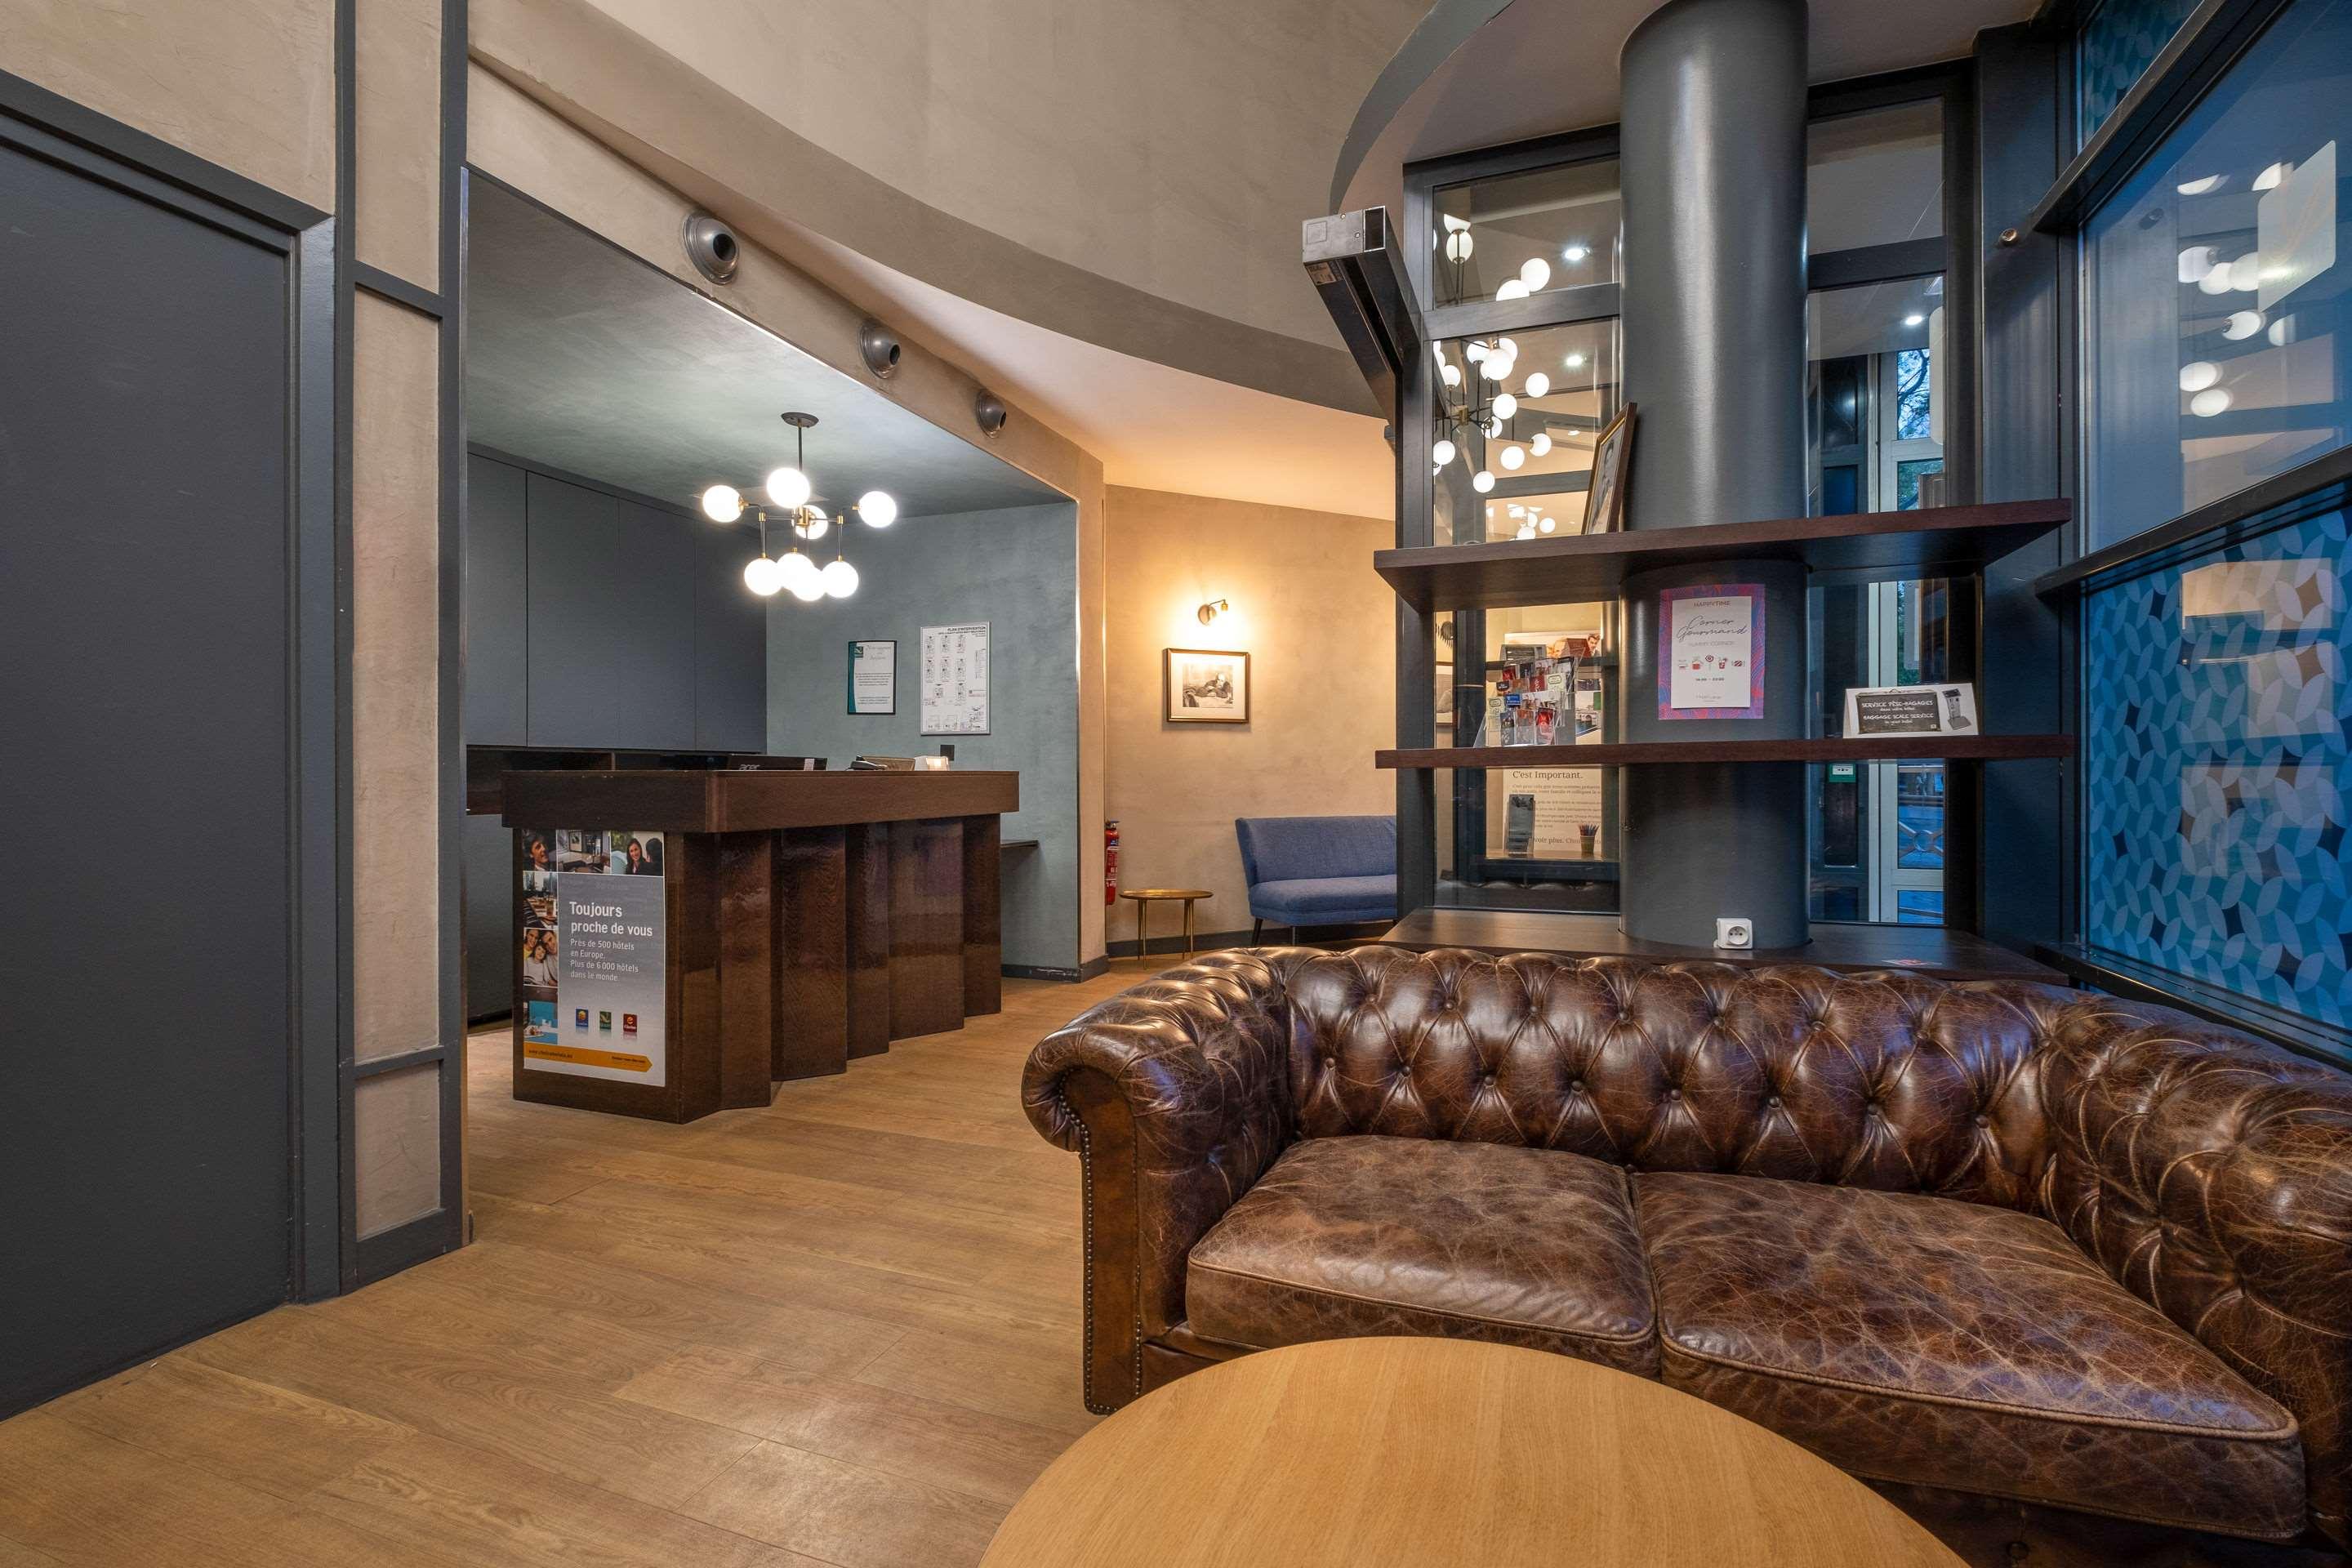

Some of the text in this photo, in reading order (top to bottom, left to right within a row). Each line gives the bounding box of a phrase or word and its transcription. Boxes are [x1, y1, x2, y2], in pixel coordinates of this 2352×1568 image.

[569, 902, 622, 917] Toujours
[572, 921, 653, 936] proche de vous
[570, 960, 585, 968] Plus
